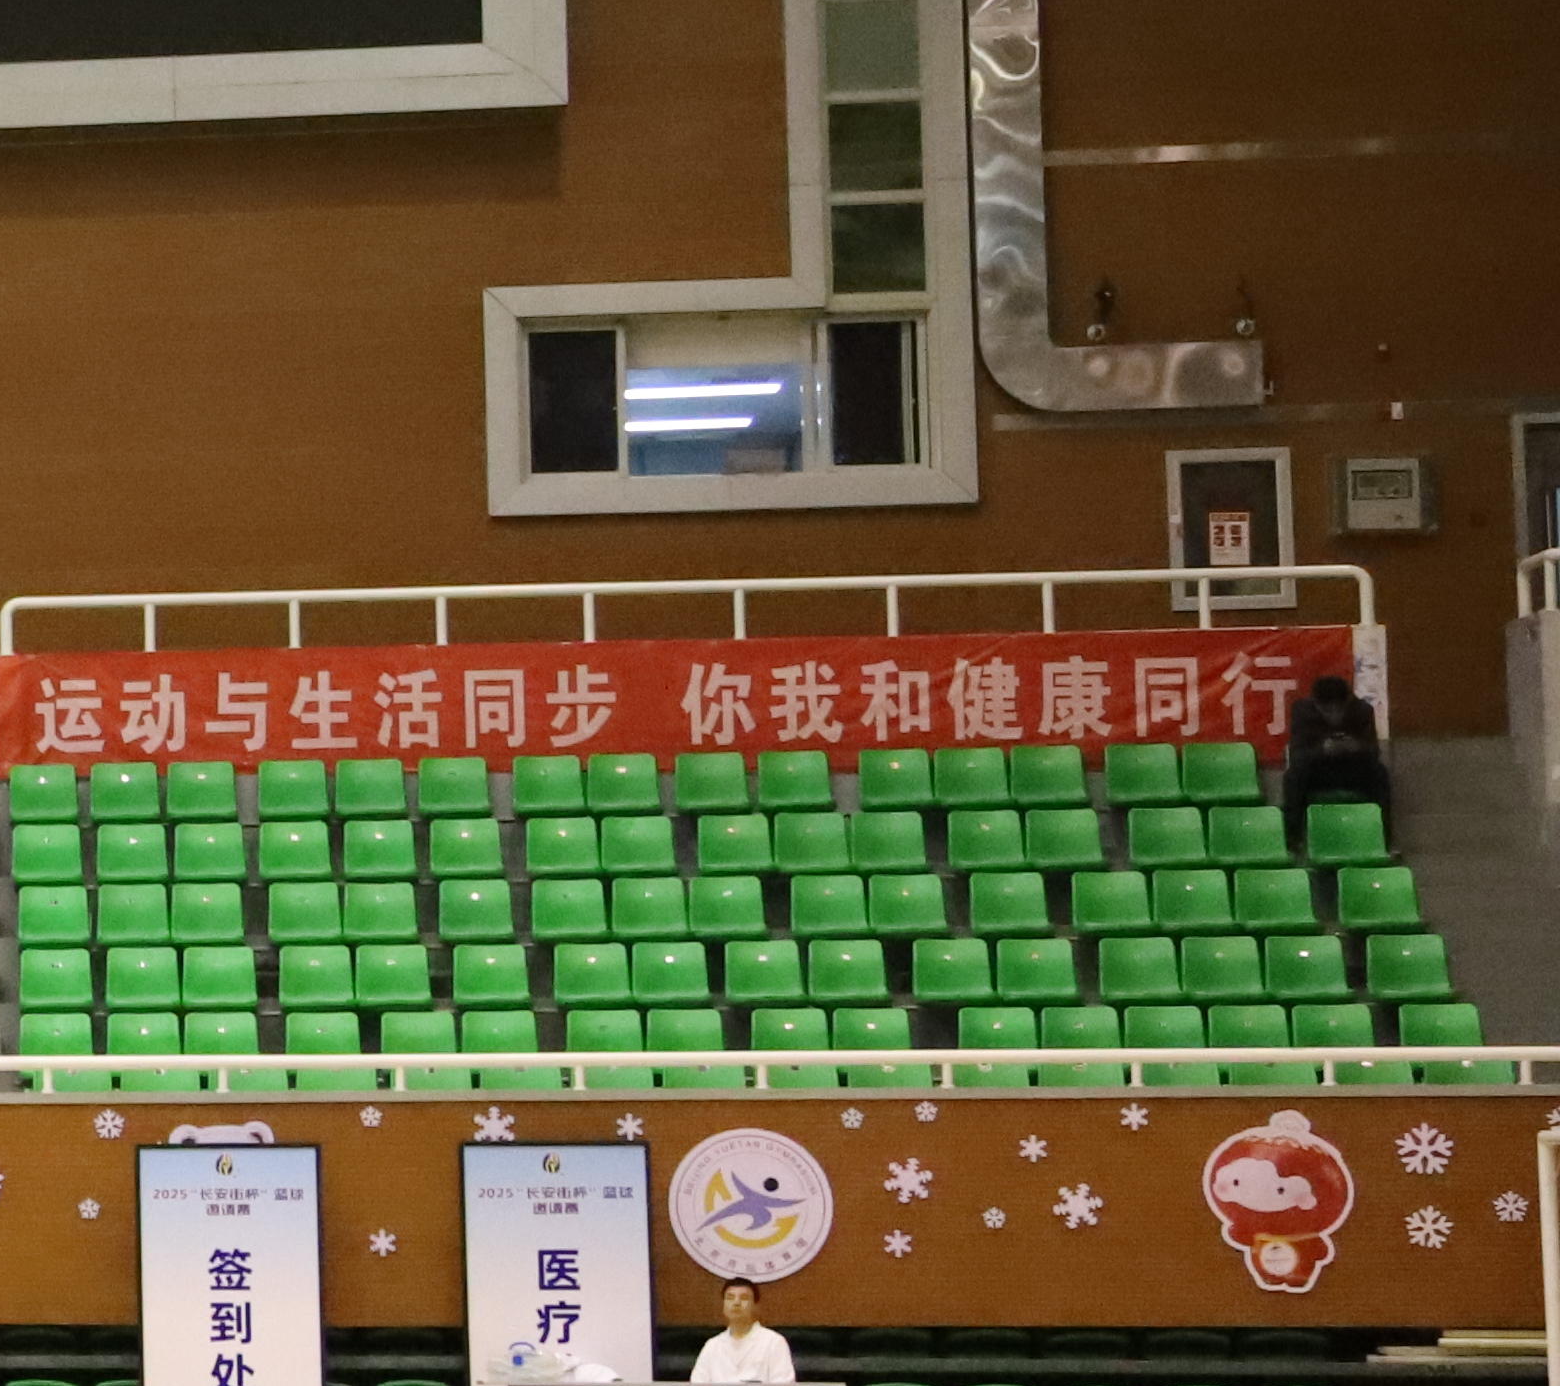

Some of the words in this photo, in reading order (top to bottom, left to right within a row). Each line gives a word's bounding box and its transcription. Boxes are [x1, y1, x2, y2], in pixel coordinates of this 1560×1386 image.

[34, 665, 617, 755] 运动与生活同步
[680, 652, 1298, 746] 你我和健康同行
